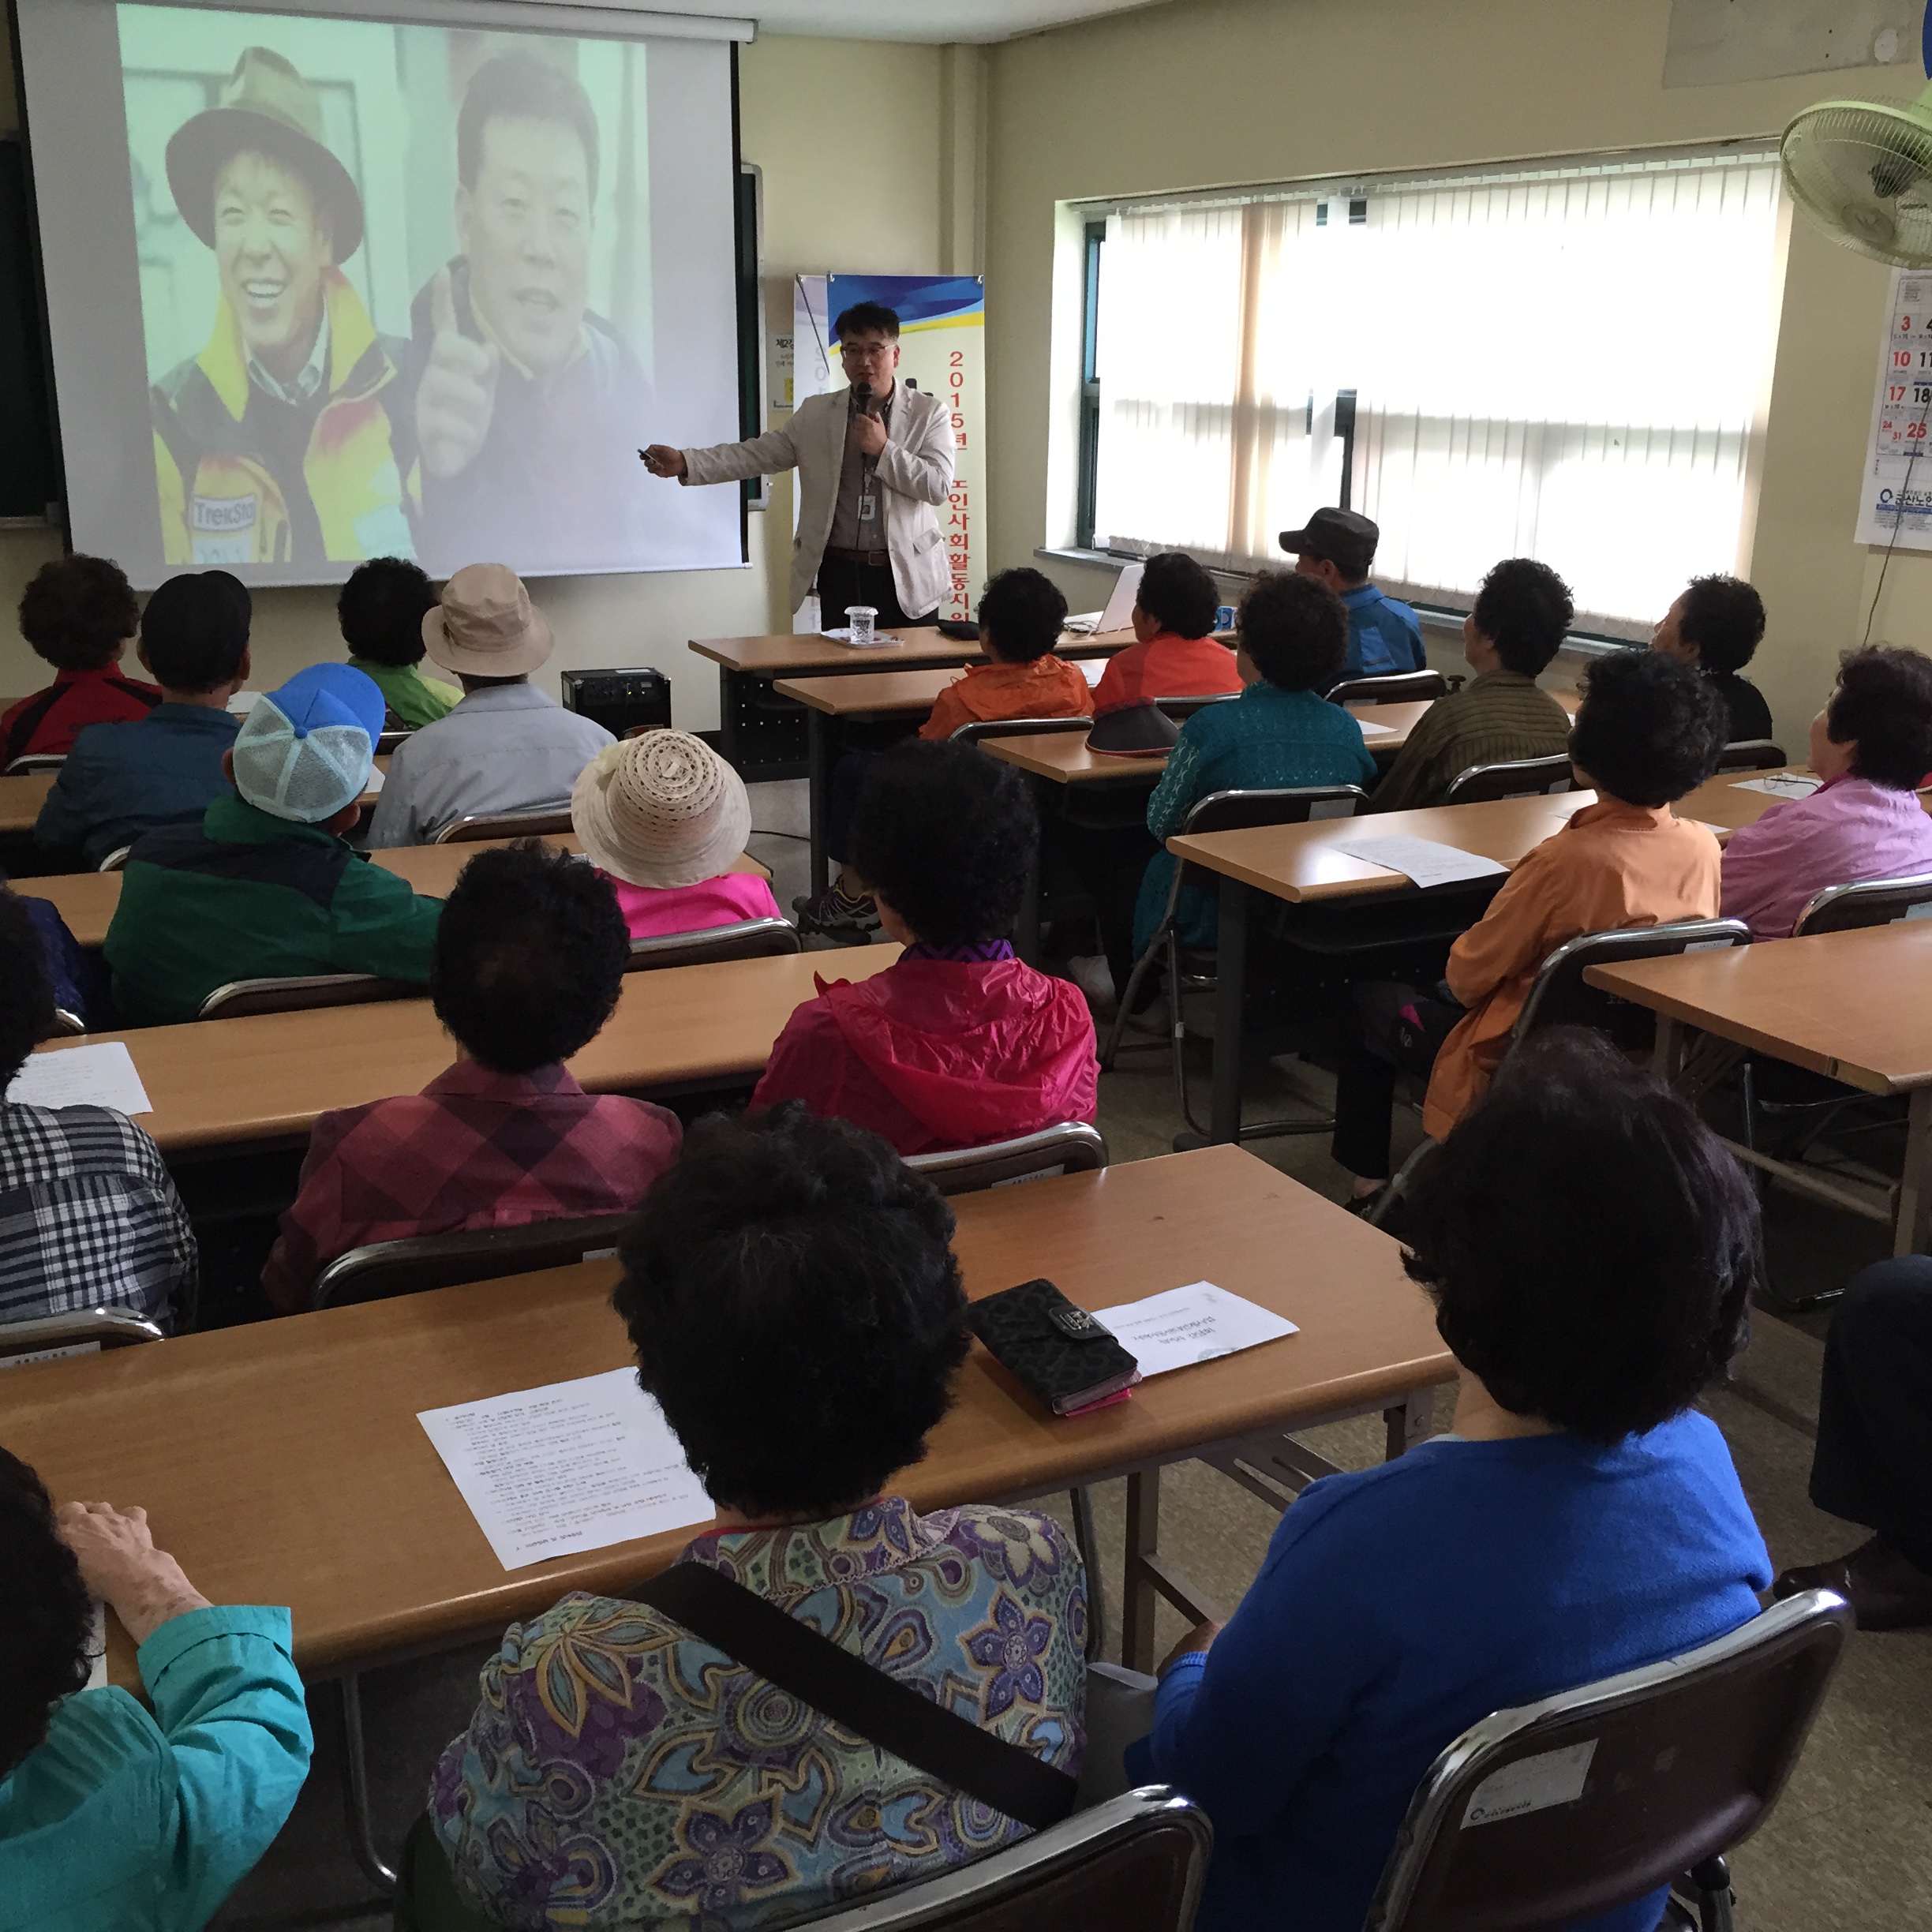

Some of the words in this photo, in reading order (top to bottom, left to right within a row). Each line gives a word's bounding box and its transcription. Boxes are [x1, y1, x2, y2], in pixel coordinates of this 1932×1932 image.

[1901, 316, 1911, 331] 3
[1893, 351, 1911, 366] 10
[1889, 386, 1906, 401] 17
[1914, 388, 1930, 402] 18
[1907, 422, 1926, 438] 25
